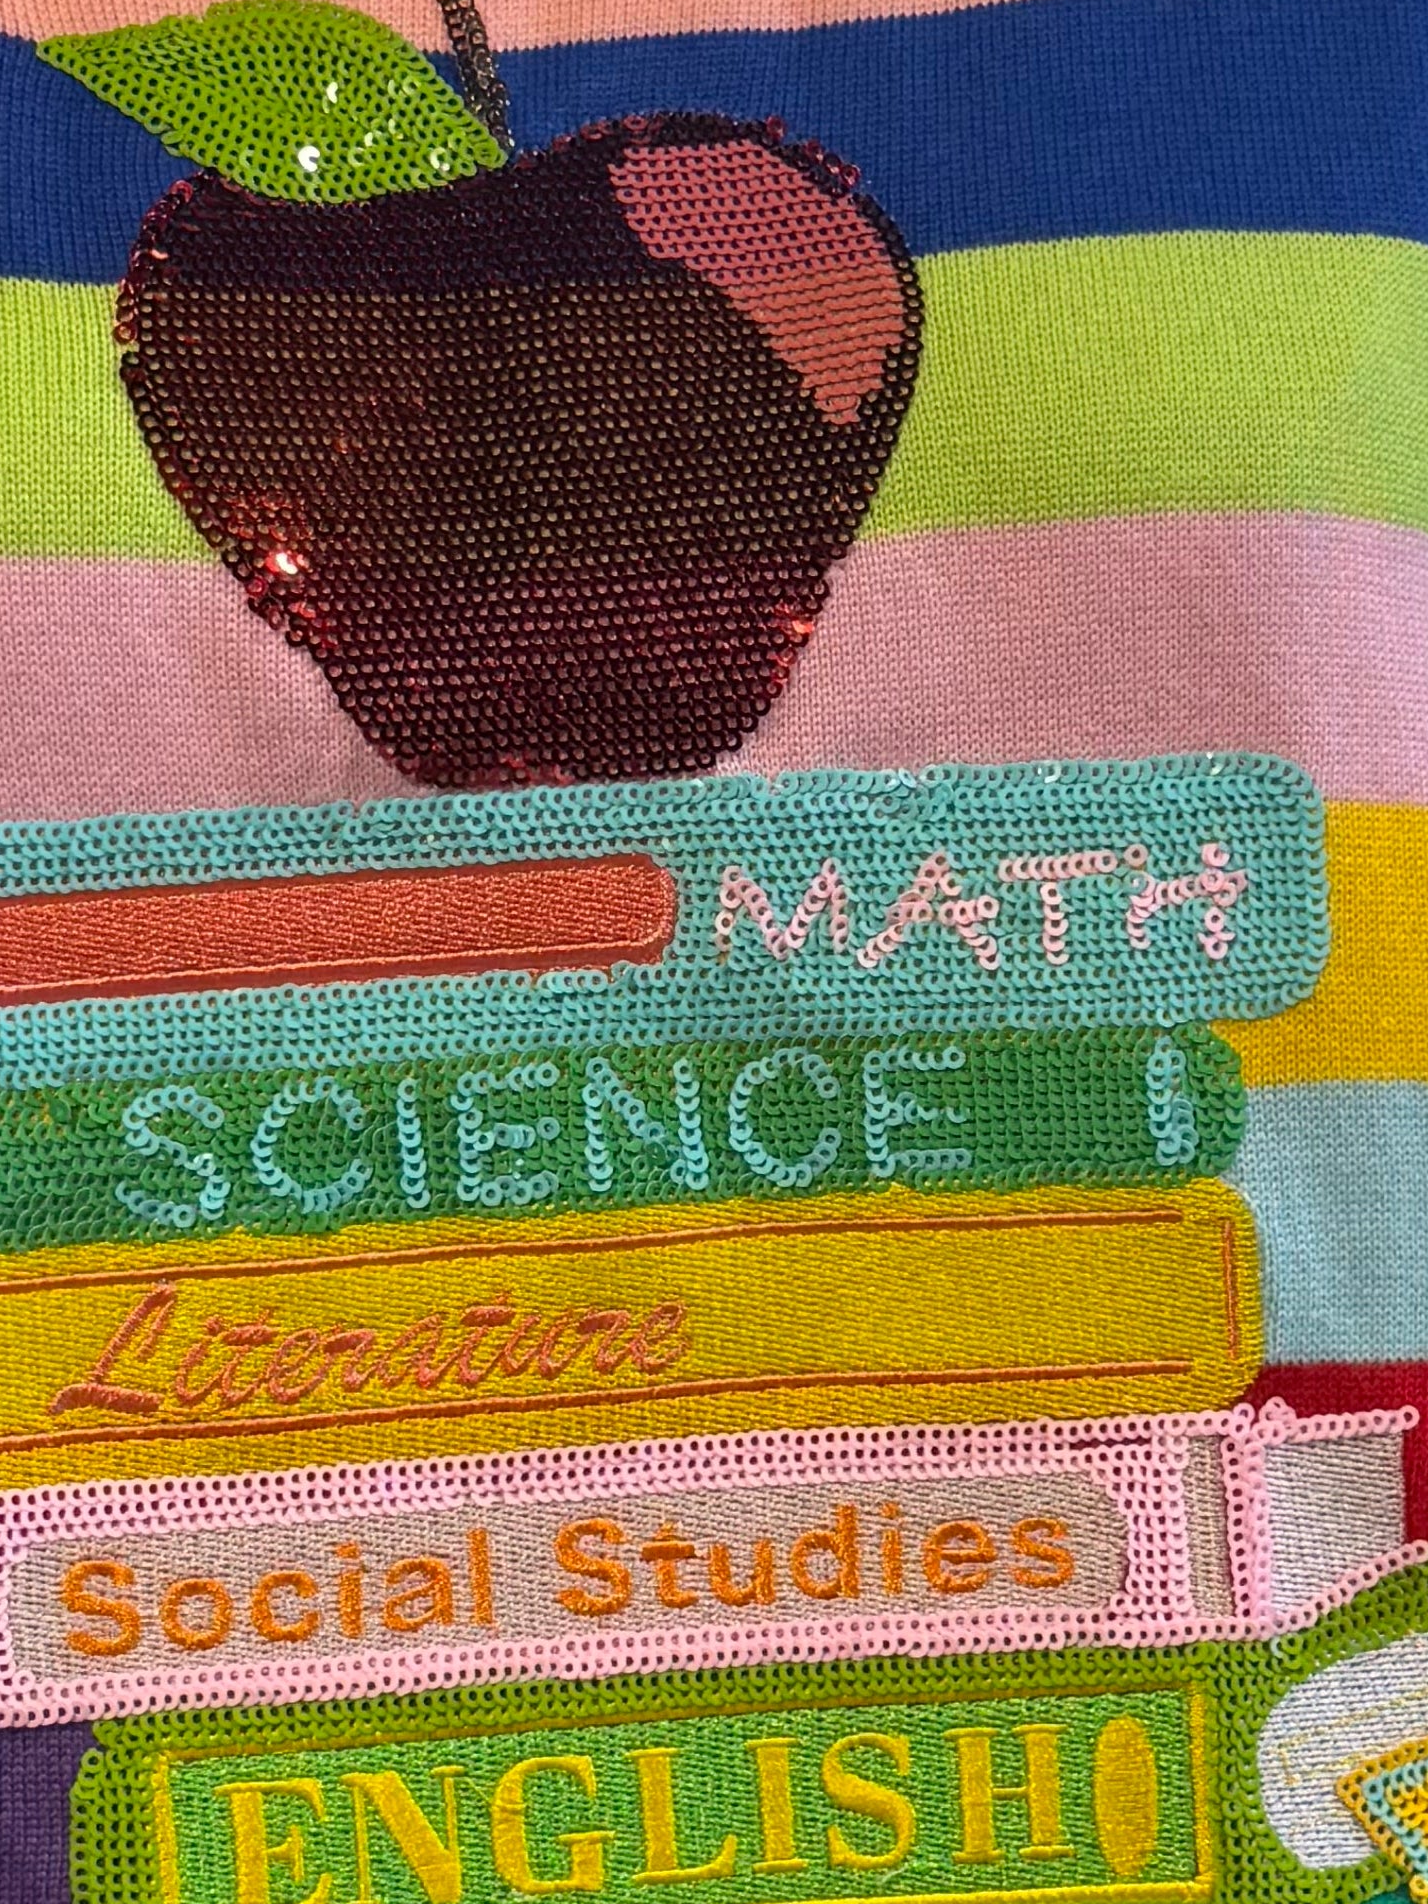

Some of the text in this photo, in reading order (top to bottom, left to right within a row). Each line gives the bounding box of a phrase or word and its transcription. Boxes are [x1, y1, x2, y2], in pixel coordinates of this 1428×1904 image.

[714, 842, 1248, 972] MATH
[113, 1041, 972, 1228] SCIENCE
[47, 1278, 688, 1416] Literature
[57, 1500, 1076, 1658] Social Studies
